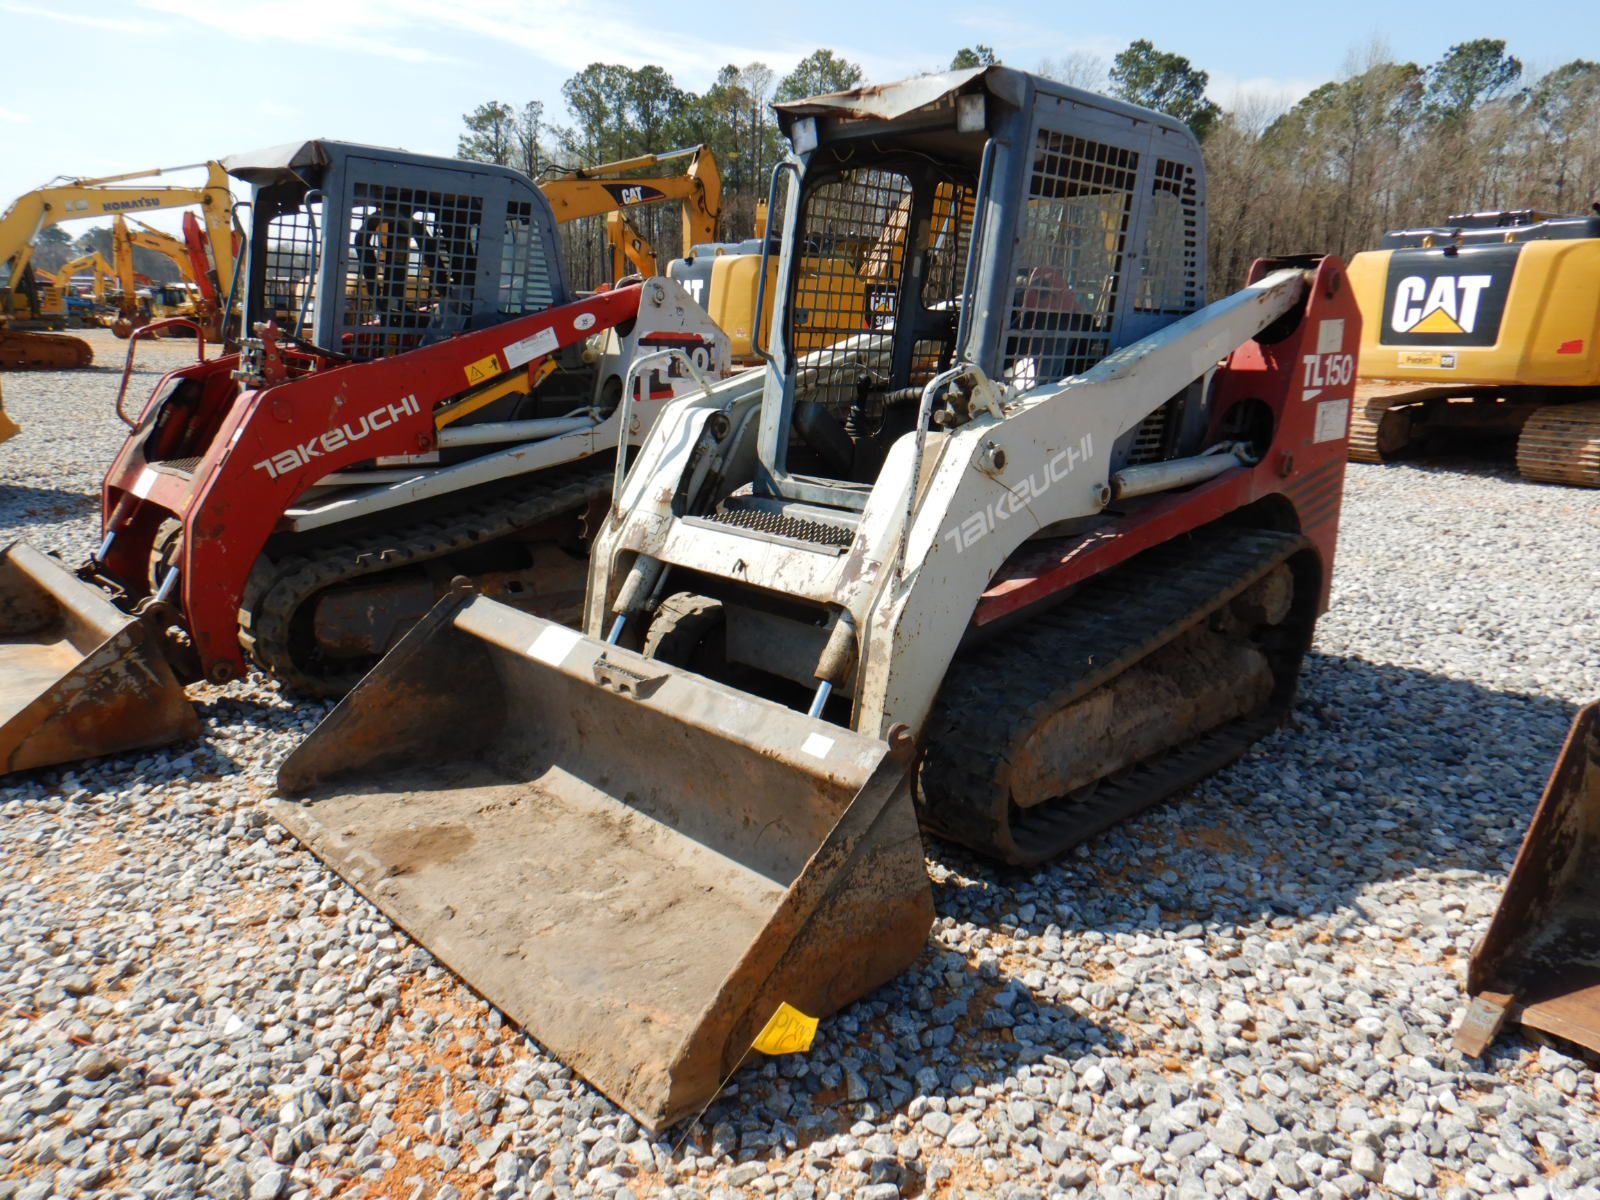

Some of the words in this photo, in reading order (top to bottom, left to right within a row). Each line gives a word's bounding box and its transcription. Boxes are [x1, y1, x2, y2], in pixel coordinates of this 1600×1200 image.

[102, 197, 160, 211] KOMATSU
[622, 186, 642, 205] CAT
[676, 279, 703, 304] AT
[1391, 275, 1492, 333] CAT
[1303, 354, 1353, 387] TL150
